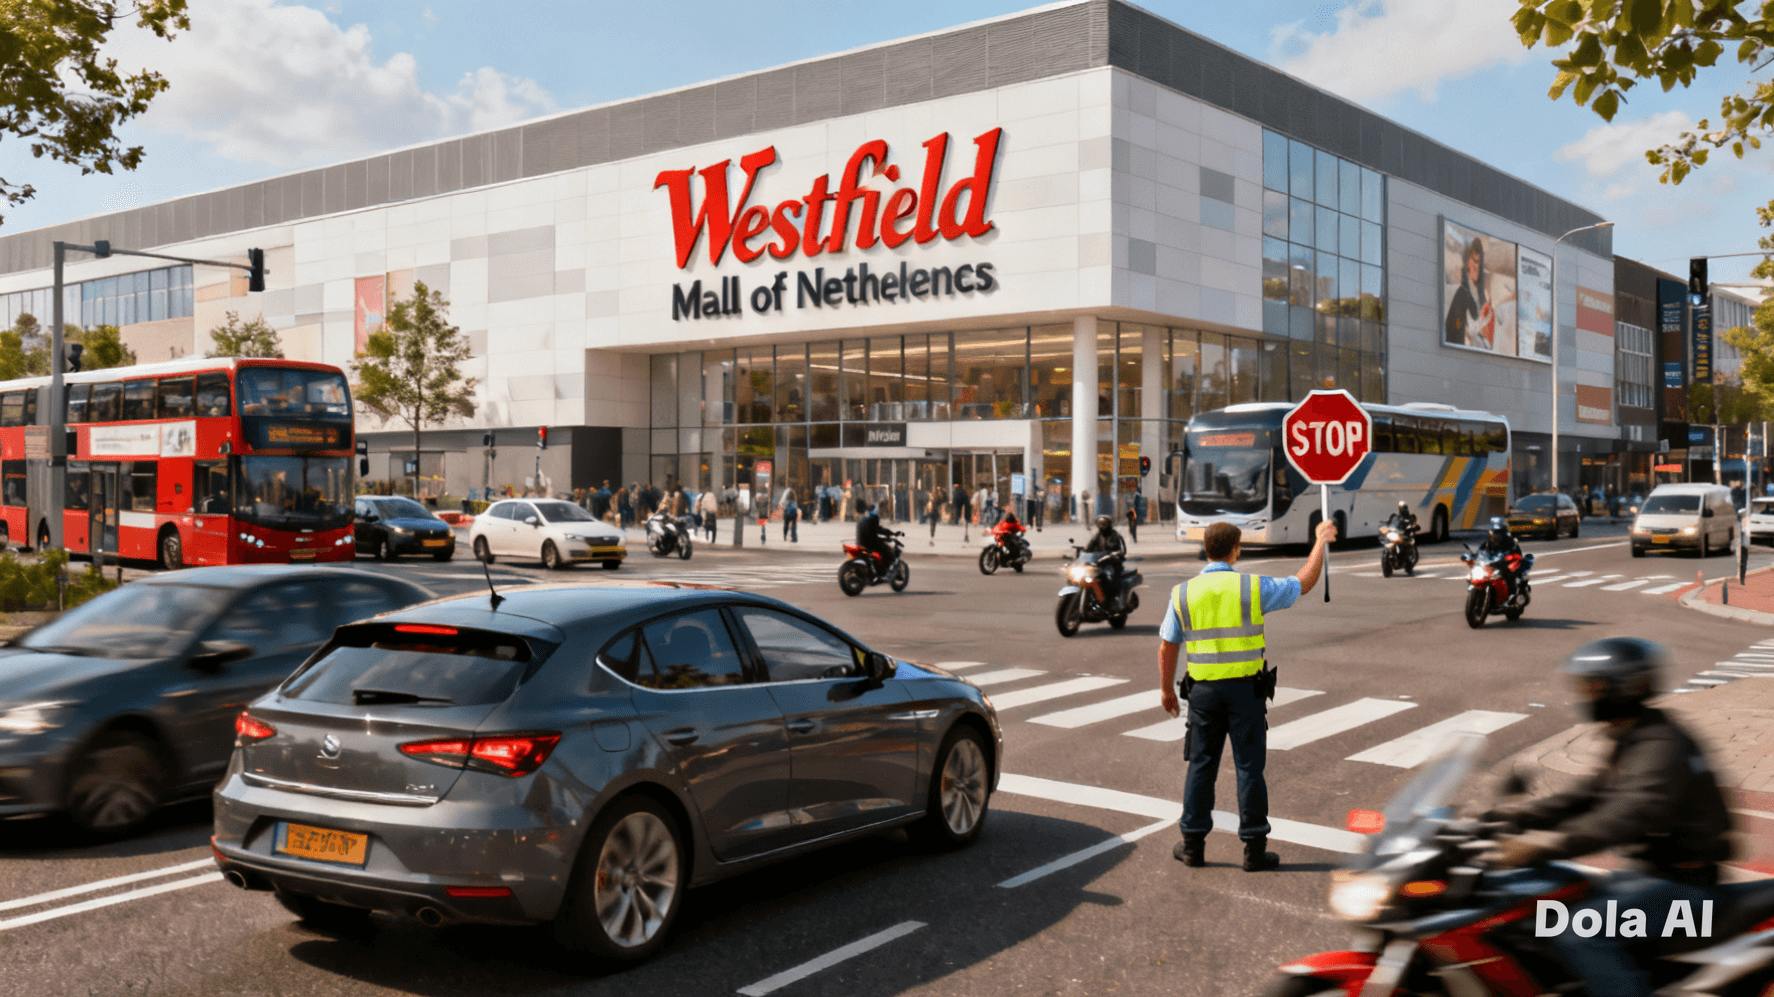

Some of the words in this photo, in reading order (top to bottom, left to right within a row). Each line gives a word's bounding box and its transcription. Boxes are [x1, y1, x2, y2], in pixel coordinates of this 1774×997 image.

[653, 127, 1002, 269] Westfield
[672, 276, 741, 321] Mall
[751, 271, 788, 312] of
[1291, 420, 1363, 457] STOP
